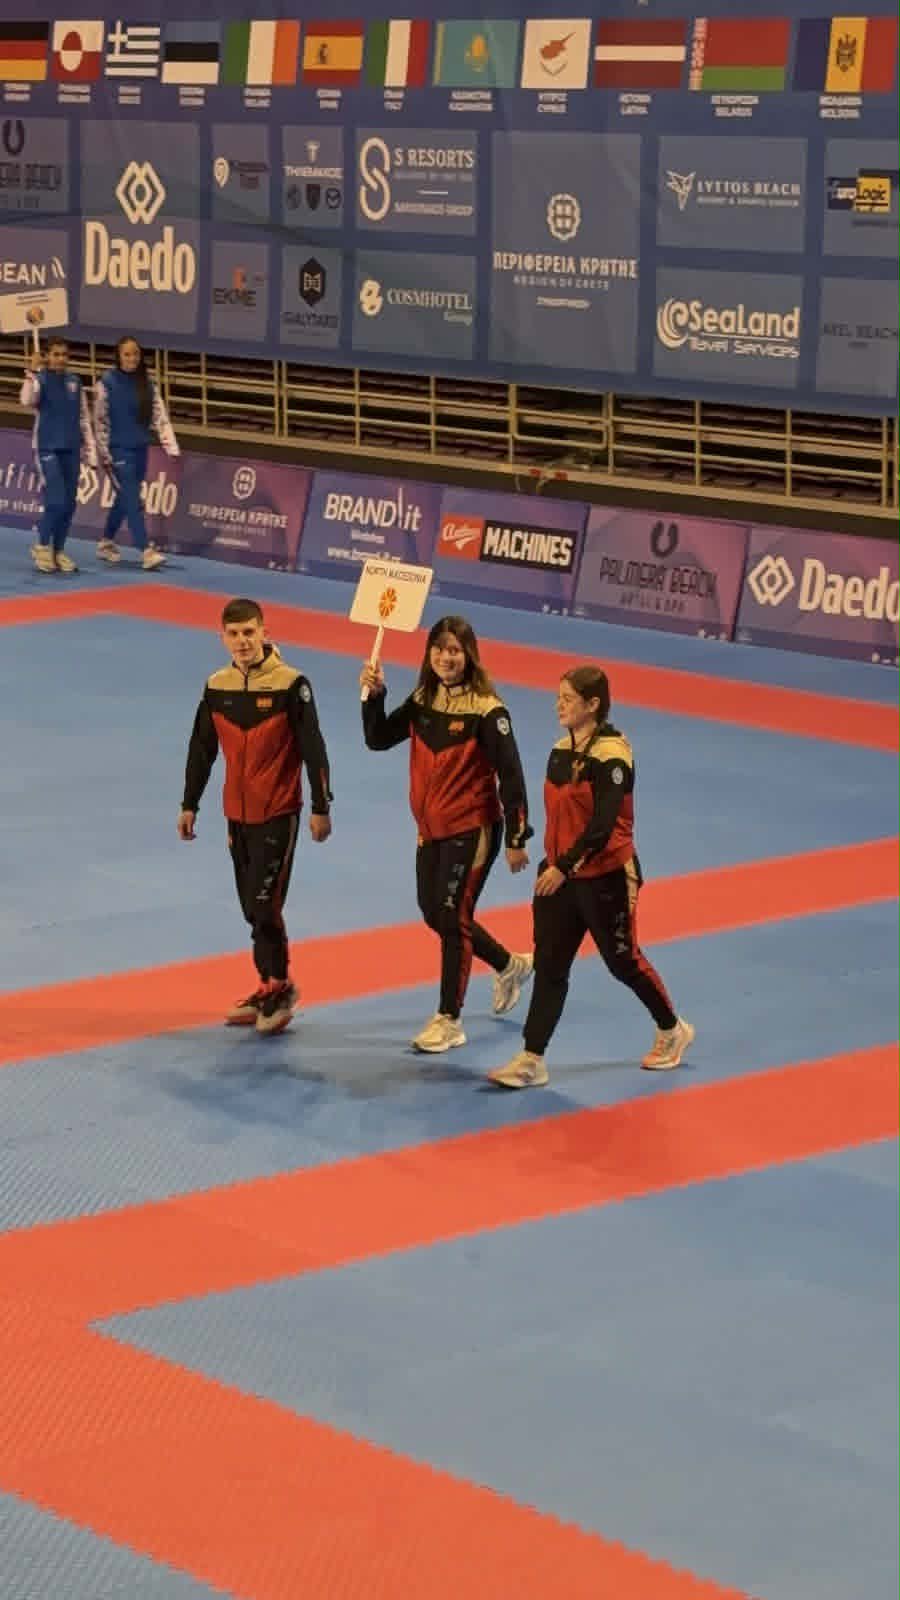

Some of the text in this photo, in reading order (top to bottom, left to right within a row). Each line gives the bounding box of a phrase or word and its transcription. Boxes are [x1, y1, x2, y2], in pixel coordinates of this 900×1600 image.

[407, 147, 474, 169] RESORTS
[0, 263, 47, 286] EAN
[84, 221, 196, 294] Daedo
[687, 299, 800, 339] SeaLand
[482, 526, 574, 567] MACHINES
[798, 558, 900, 623] Daedo
